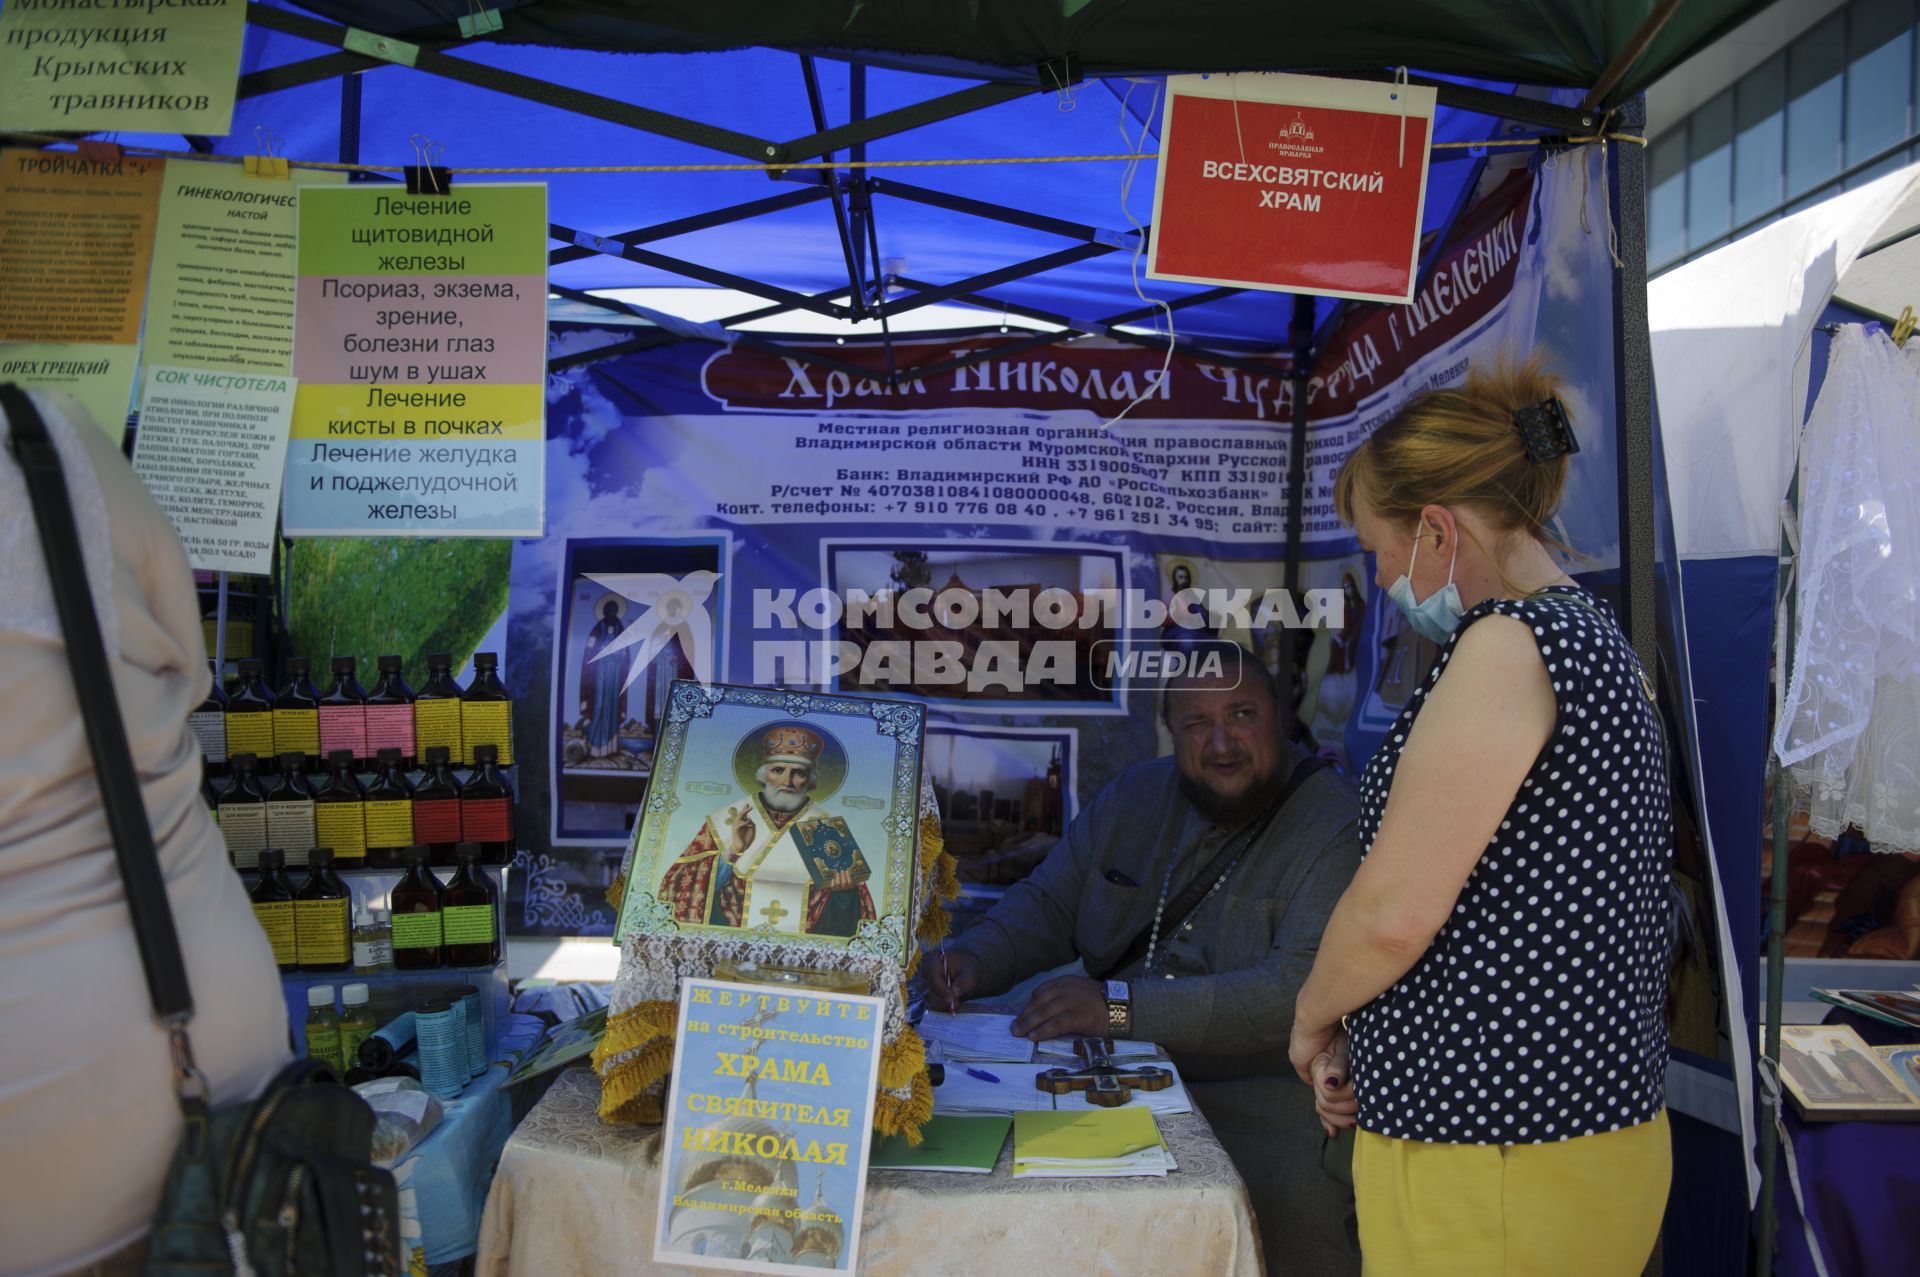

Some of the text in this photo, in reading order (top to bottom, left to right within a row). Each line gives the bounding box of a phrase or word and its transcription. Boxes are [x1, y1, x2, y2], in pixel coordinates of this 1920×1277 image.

[6, 27, 167, 48] продукция
[32, 56, 187, 82] Крымских
[50, 94, 209, 115] травников
[1269, 142, 1324, 153] ПРАВОСЛАВНАЯ
[17, 154, 123, 177] ТРОЙЧАТКА
[1202, 160, 1384, 193] ВСЕХСВЯТСКИЙ
[374, 196, 472, 216] Лечение
[1259, 190, 1321, 212] ХРАМ
[226, 209, 269, 221] НАСТОЙ
[351, 224, 494, 246] щитовидной
[378, 253, 465, 271] железы
[322, 279, 520, 302] Псориаз, экзема,
[376, 309, 463, 330] зрение,
[344, 334, 495, 353] болезни глаз
[2, 359, 111, 376] ОРЕХ ГРЕЦКИЙ
[350, 364, 487, 386] шум в ушах
[155, 370, 287, 392] СОК ЧИСТОТЕЛА
[366, 389, 466, 408] Лечение
[328, 419, 503, 435] кисты в почках
[817, 422, 901, 436] Местная
[907, 423, 1030, 438] религиозная
[311, 443, 517, 467] Лечение желудка
[795, 436, 937, 451] Владимирской
[943, 437, 1022, 451] области
[1217, 453, 1287, 469] Русской
[836, 469, 890, 481] Банк:
[896, 469, 1045, 486] Владимирский
[1046, 473, 1072, 487] РФ
[1077, 475, 1101, 488] АО
[1021, 456, 1061, 470] ИНН
[1181, 469, 1221, 483] КПП
[310, 472, 518, 497] и поджелудочной
[770, 484, 834, 498] Р/счет
[840, 484, 861, 497] №
[367, 504, 457, 520] железы
[716, 503, 765, 515] Конт.
[770, 501, 876, 517] телефоны:
[884, 502, 907, 514] +7
[914, 502, 948, 514] 910
[955, 502, 989, 514] 776
[995, 503, 1018, 515] 08
[1023, 504, 1047, 516] 40
[1066, 507, 1087, 521] +7
[1093, 508, 1125, 523] 961
[1130, 511, 1160, 526] 251
[1167, 514, 1189, 528] 34
[1231, 520, 1278, 534] сайт:
[691, 987, 871, 1020] ЖЕРТВУЙТЕ
[687, 1019, 868, 1049] на строительство
[713, 1052, 832, 1086] ХРАМА
[687, 1092, 851, 1128] СВЯТИТЕЛЯ
[681, 1126, 849, 1166] НИКОЛАЯ
[785, 1206, 843, 1224] область
